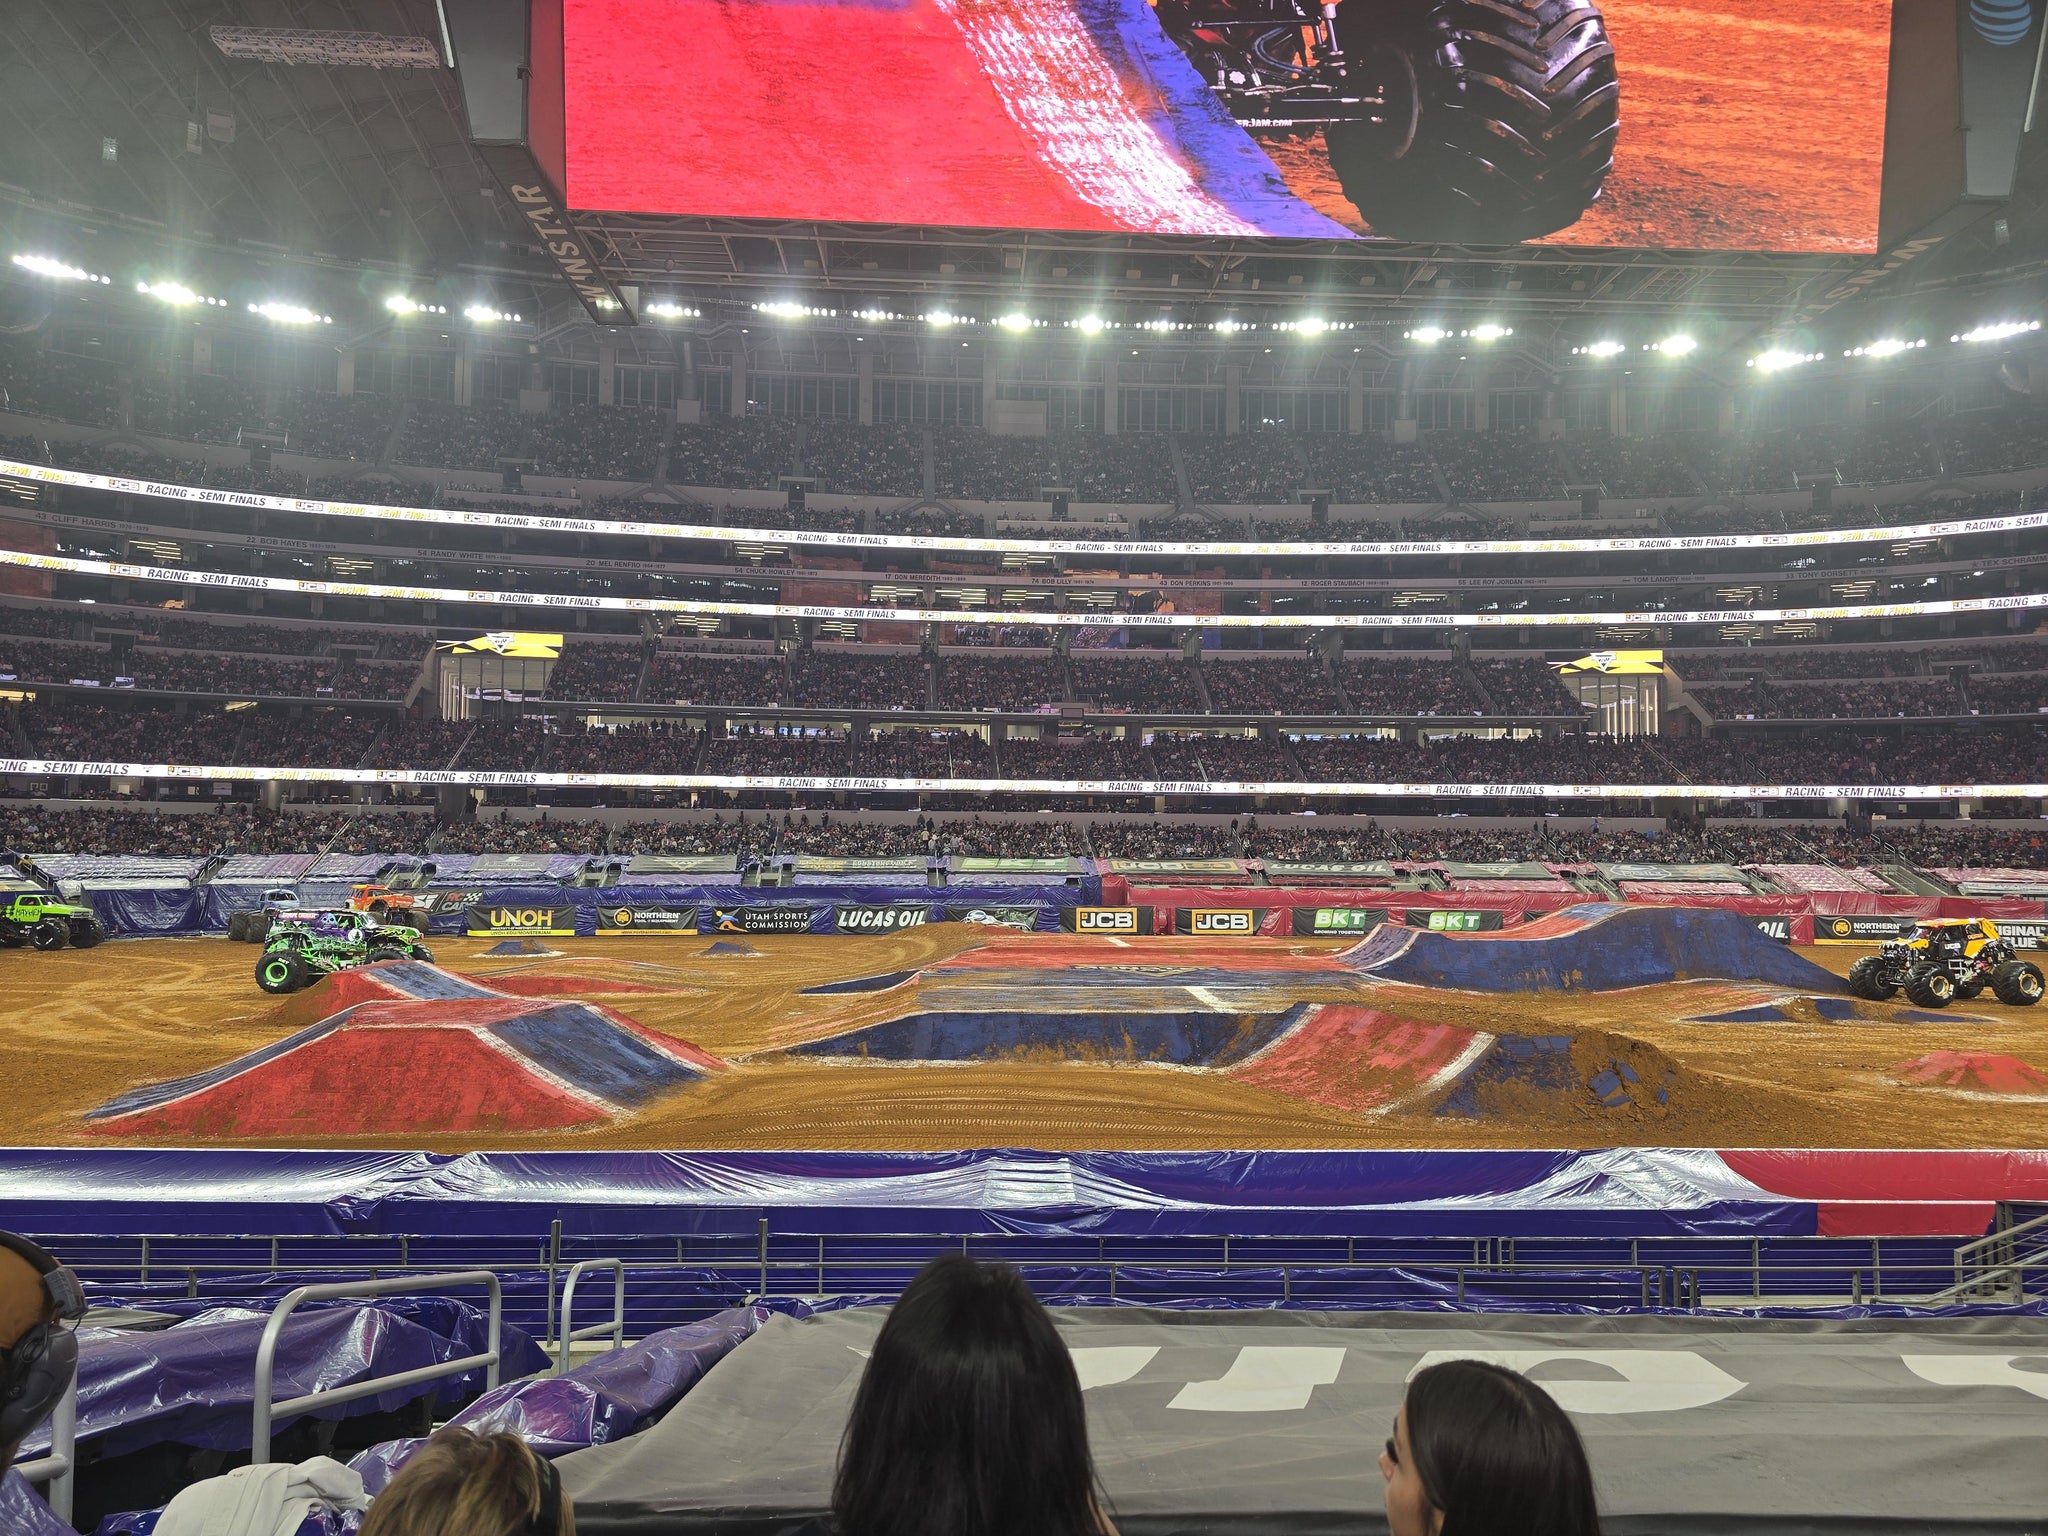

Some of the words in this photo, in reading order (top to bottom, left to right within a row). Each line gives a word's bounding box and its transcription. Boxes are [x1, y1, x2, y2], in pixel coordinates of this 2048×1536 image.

[146, 485, 188, 498] RACING
[199, 491, 226, 502] SEMI
[229, 494, 266, 506] FINALS
[36, 512, 46, 520] 43
[52, 514, 78, 524] CLIFF
[82, 518, 116, 529] HARRIS
[495, 516, 529, 526] RACING
[540, 519, 561, 528] SEMI
[564, 521, 595, 530] FINALS
[1965, 520, 2004, 530] RACING
[2016, 517, 2042, 527] SEMI
[281, 540, 308, 548] HAYES
[797, 534, 828, 543] RACING
[860, 537, 888, 545] FINALS
[1639, 540, 1671, 549] RACING
[1681, 539, 1703, 547] SEMI
[1706, 537, 1737, 546] FINALS
[147, 569, 189, 581] RACING
[201, 574, 228, 584] SEMI
[231, 576, 268, 588] FINALS
[500, 594, 534, 603] RACING
[544, 596, 566, 605] SEMI
[569, 598, 600, 607] FINALS
[1988, 597, 2028, 608] RACING
[804, 608, 835, 616] RACING
[1655, 614, 1688, 622] RACING
[1698, 613, 1720, 621] SEMI
[1723, 612, 1754, 620] FINALS
[43, 762, 78, 773] SEMI
[82, 764, 129, 774] FINALS
[414, 772, 456, 782] RACING
[468, 773, 495, 782] SEMI
[499, 774, 536, 783] FINALS
[779, 779, 815, 787] RACING
[826, 779, 850, 787] SEMI
[854, 780, 887, 788] FINALS
[1436, 786, 1472, 794] RACING
[1482, 786, 1507, 794] SEMI
[1510, 786, 1544, 794] FINALS
[1785, 788, 1825, 796] RACING
[1837, 788, 1864, 796] SEMI
[1869, 788, 1905, 796] FINALS
[1271, 863, 1343, 872] LUCAS
[490, 907, 552, 926] UNOH
[838, 911, 896, 927] LUCAS
[1081, 913, 1133, 928] JCB
[1196, 914, 1248, 929] JCB
[1316, 911, 1365, 926] BKT
[1430, 914, 1478, 929] BKT
